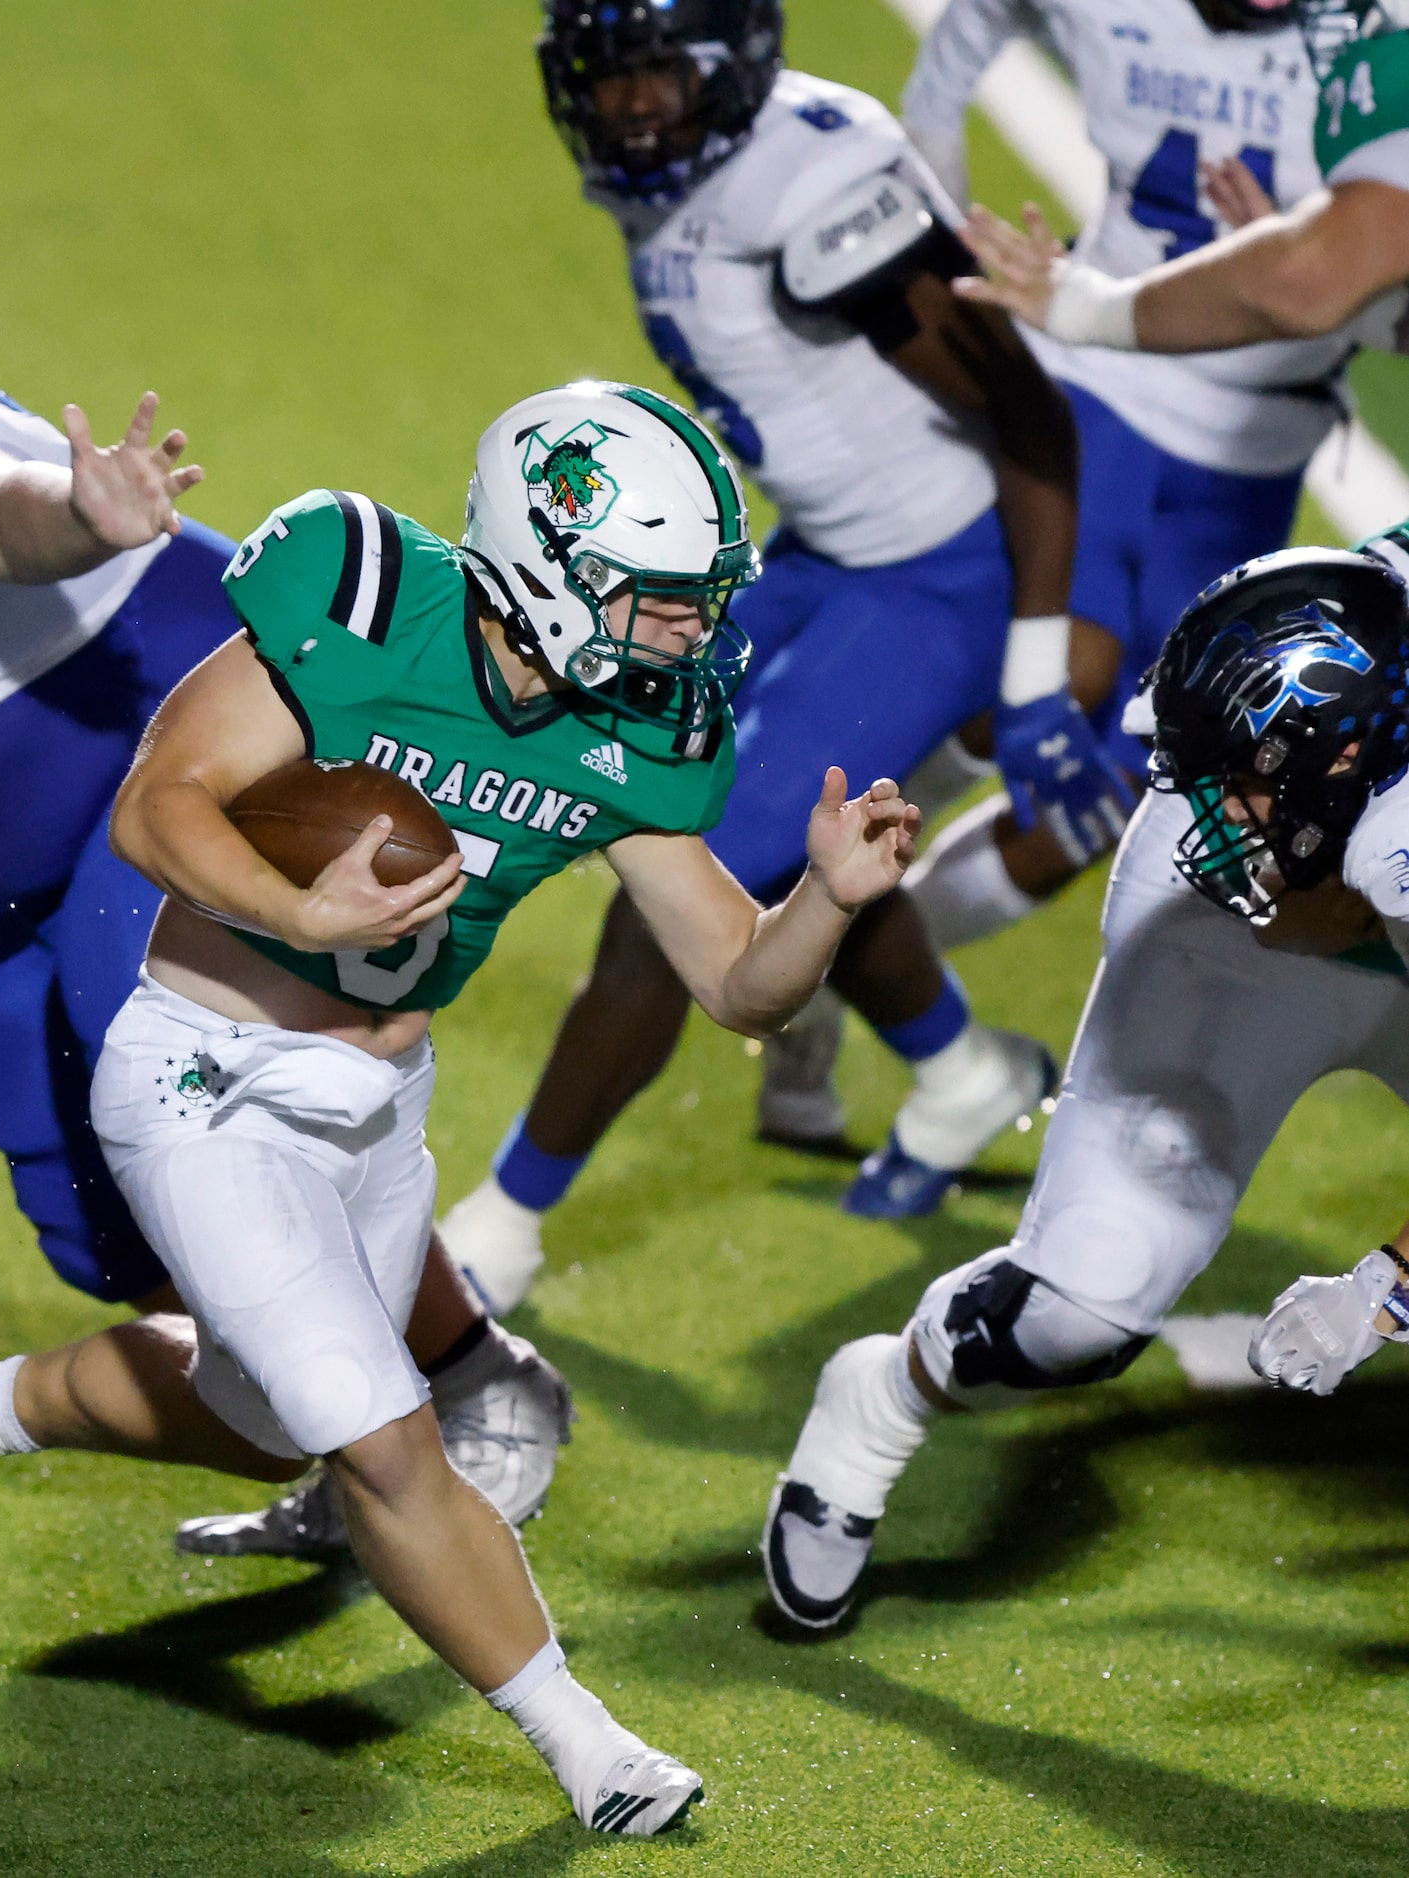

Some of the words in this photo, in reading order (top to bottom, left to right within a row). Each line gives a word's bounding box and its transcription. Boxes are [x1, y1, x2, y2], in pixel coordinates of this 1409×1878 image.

[1125, 61, 1282, 137] BOBCATS
[1324, 61, 1377, 138] 74
[232, 517, 290, 579] 5
[364, 733, 599, 838] DRAGONS
[579, 751, 628, 785] adidas
